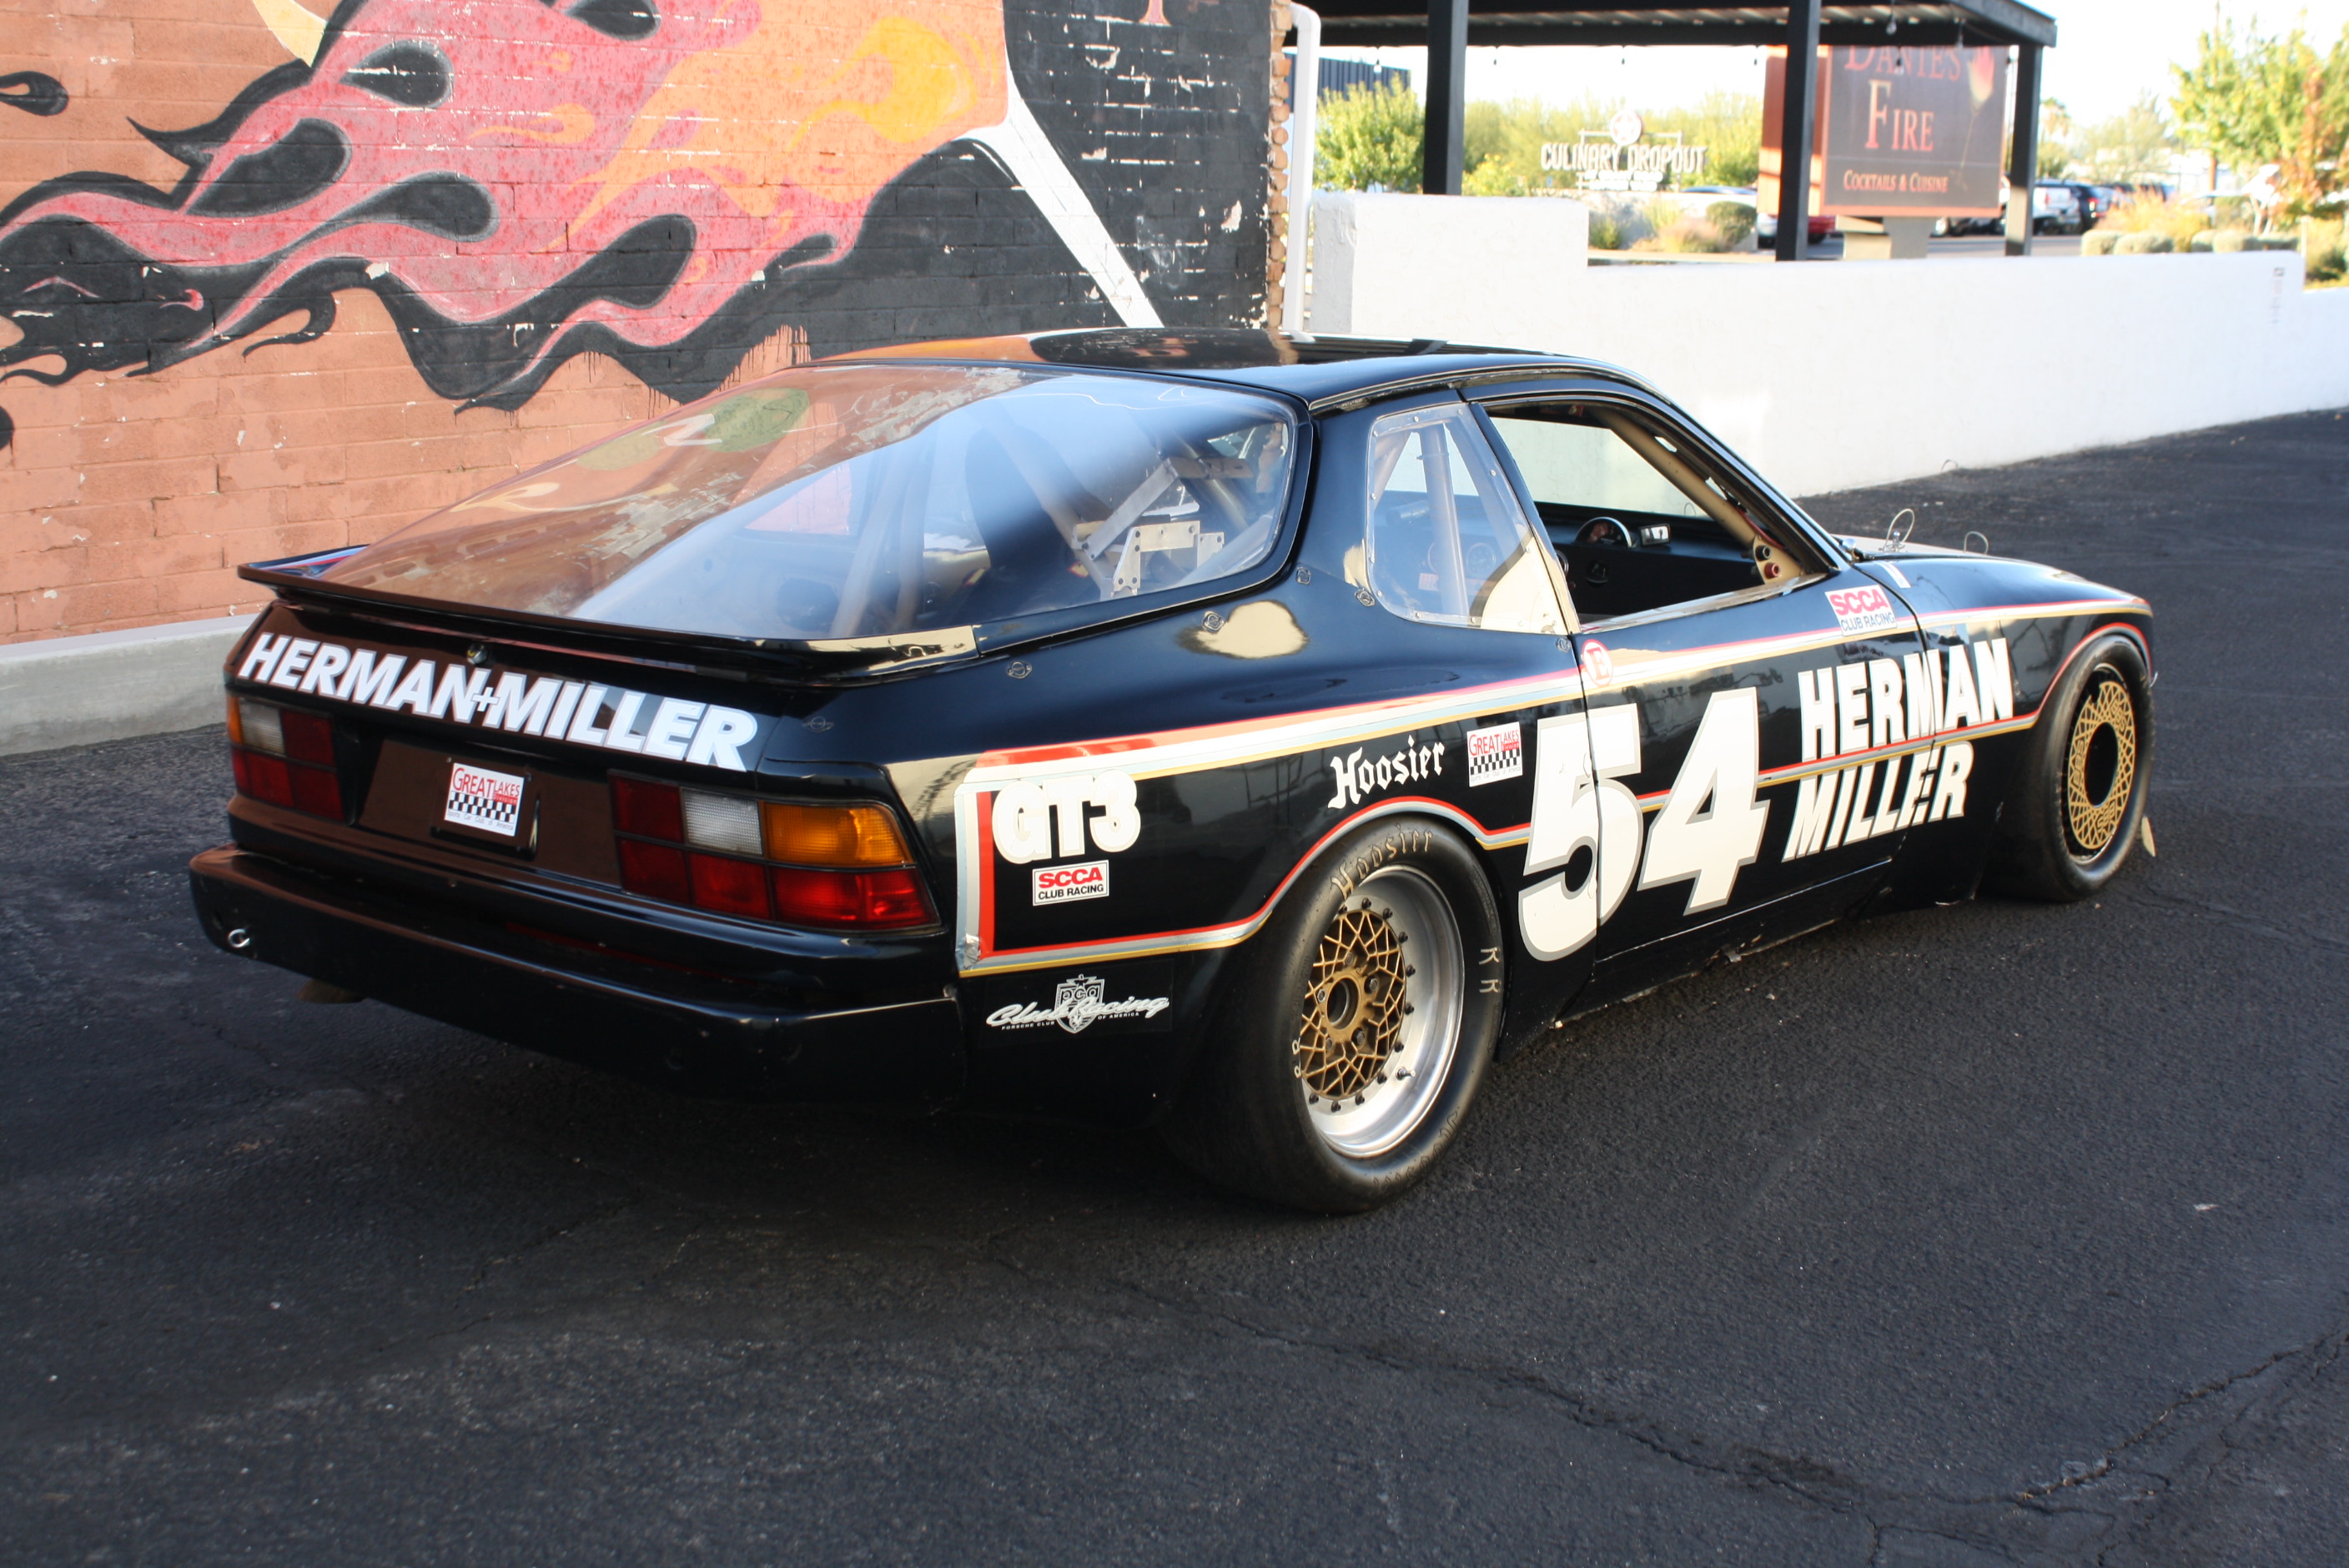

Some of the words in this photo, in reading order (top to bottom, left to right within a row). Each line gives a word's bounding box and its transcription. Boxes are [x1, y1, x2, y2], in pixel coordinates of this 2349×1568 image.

[1864, 78, 1934, 152] FIRE
[1541, 143, 1622, 171] CULINARY
[1627, 143, 1708, 173] DROPOUT
[1843, 169, 1897, 192] COCKTAILS
[1899, 173, 1908, 192] &
[1909, 172, 1949, 193] CUISINE
[1829, 589, 1889, 616] SCCA
[1841, 616, 1864, 631] CLUB
[1864, 611, 1895, 628] RACING
[1586, 646, 1611, 681] E
[1798, 637, 2015, 763] HERMAN
[1469, 734, 1500, 756] GREAT
[1500, 730, 1520, 744] LAKES
[453, 767, 495, 798] GREAT
[494, 781, 521, 797] LAKES
[1328, 734, 1446, 809] Hoosier
[992, 769, 1141, 864] GT3
[1781, 741, 1974, 863] MILLER
[1518, 686, 1771, 962] 54
[1331, 822, 1432, 901] Hoosier
[1038, 888, 1064, 900] CLUB
[1067, 884, 1104, 897] RACING
[1039, 867, 1104, 889] SCCA
[986, 998, 1072, 1027] Club
[1068, 996, 1170, 1018] Racing
